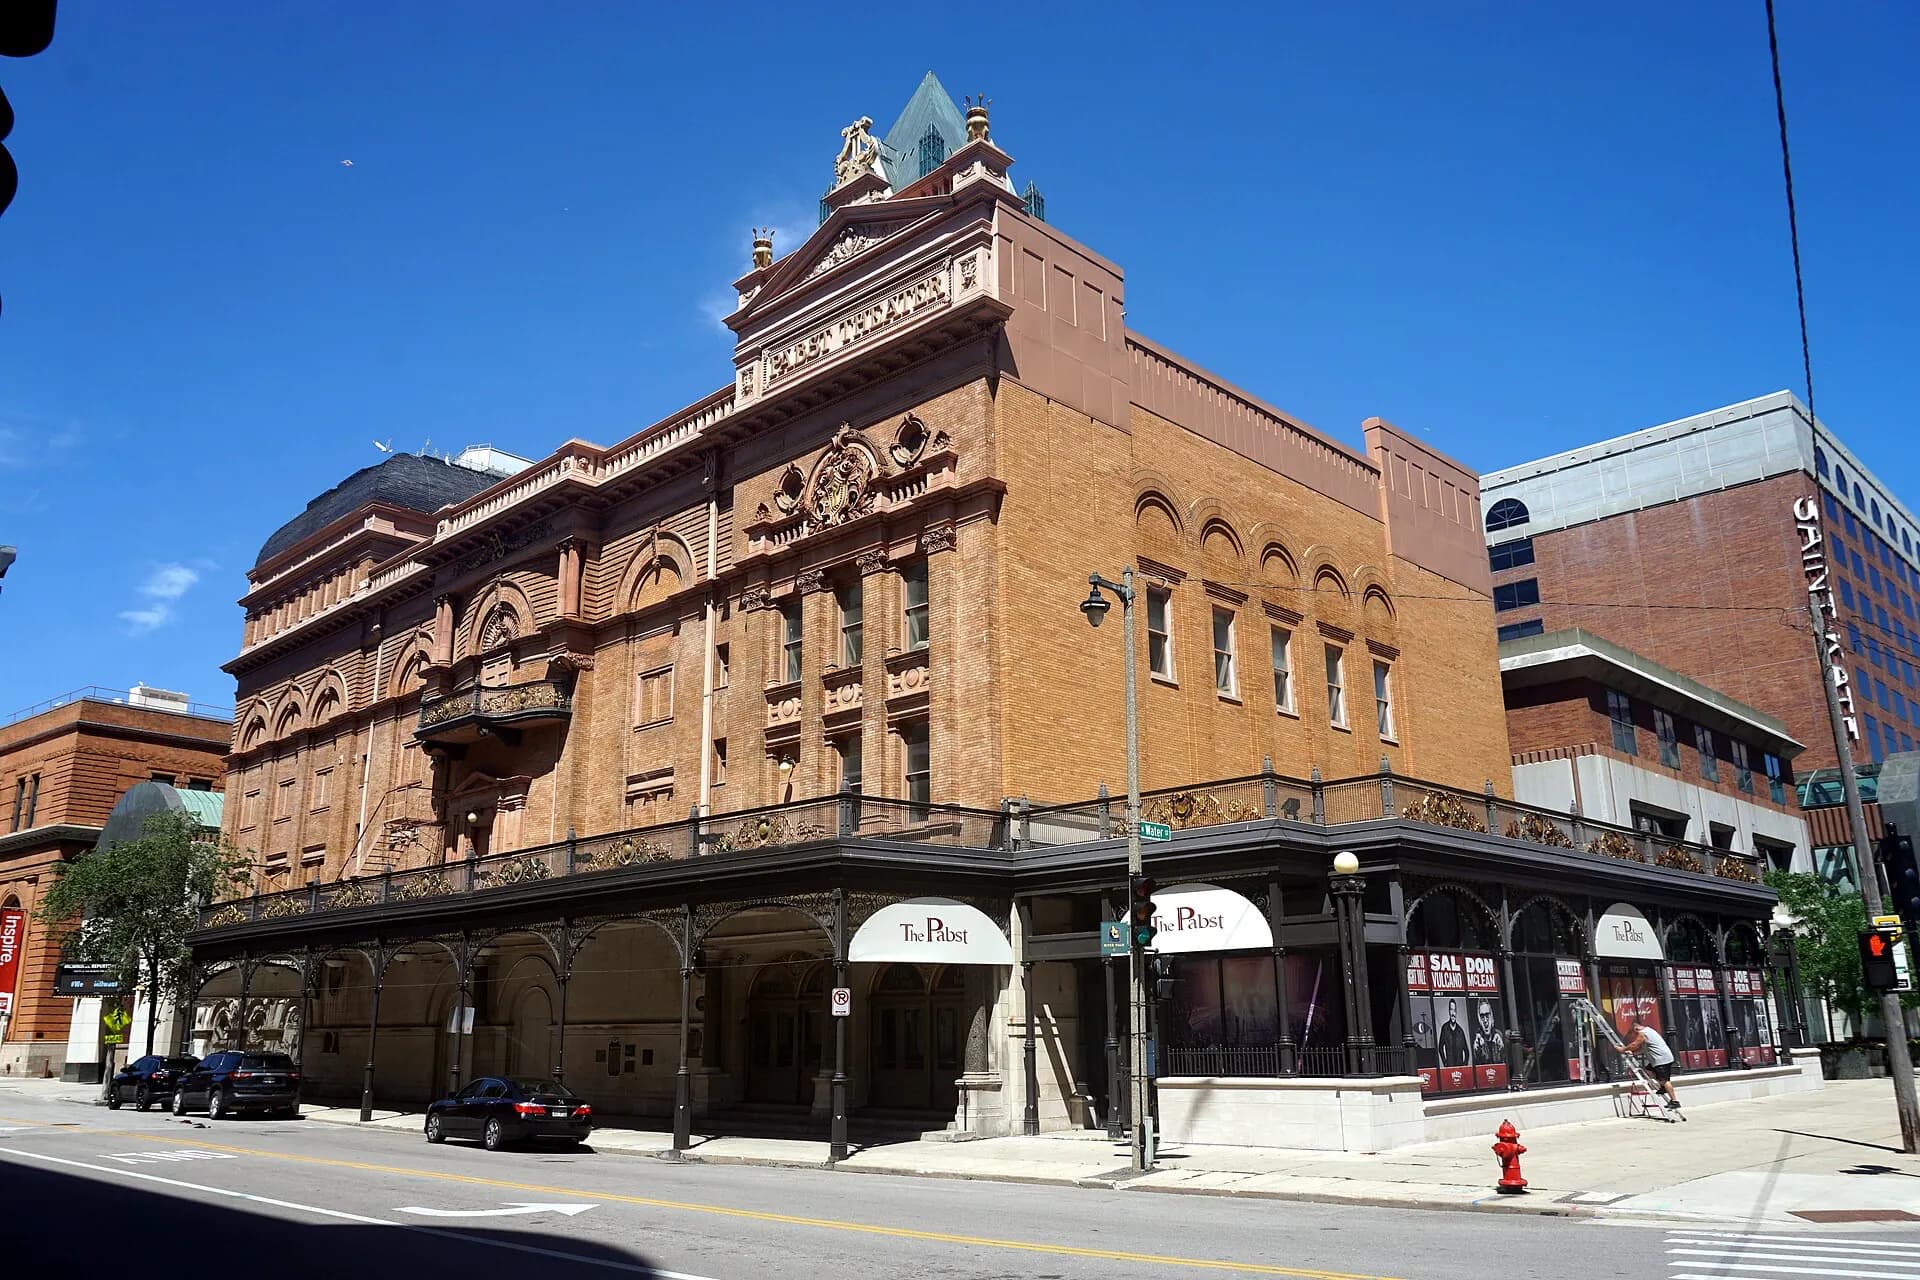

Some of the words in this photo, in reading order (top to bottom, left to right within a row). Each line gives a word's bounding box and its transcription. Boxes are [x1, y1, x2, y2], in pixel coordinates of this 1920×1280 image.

[769, 329, 834, 379] PABST
[839, 275, 946, 345] THEATER
[1793, 496, 1837, 619] SAINT
[1145, 824, 1164, 838] Water
[1151, 915, 1175, 934] The
[1176, 906, 1224, 931] Pabst
[0, 915, 22, 966] Inspire.
[899, 923, 925, 943] The
[925, 917, 968, 945] Pabst
[1612, 925, 1625, 942] The
[1624, 920, 1645, 944] Pabst
[1430, 954, 1460, 971] SAL
[1465, 957, 1494, 974] DON
[1431, 971, 1462, 988] VULCANO
[1695, 968, 1713, 979] LORD
[1733, 970, 1749, 983] JOE
